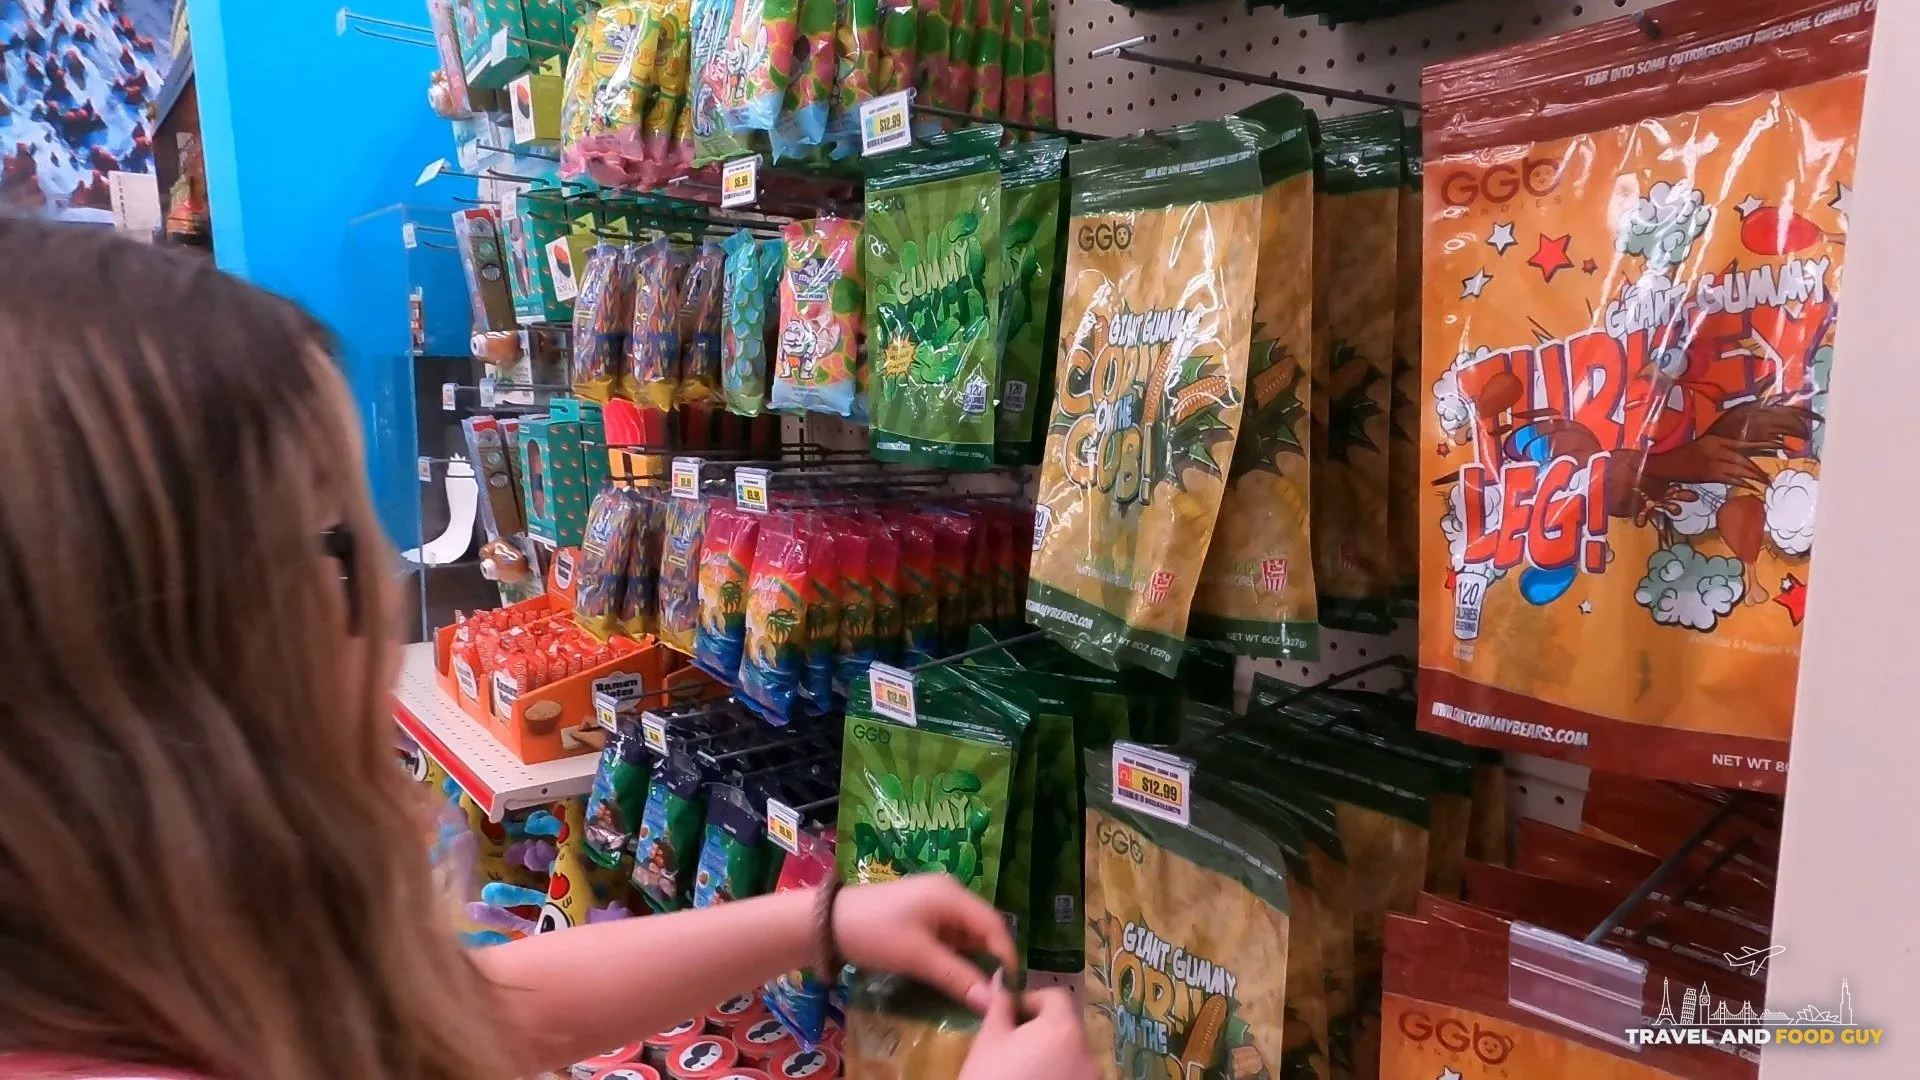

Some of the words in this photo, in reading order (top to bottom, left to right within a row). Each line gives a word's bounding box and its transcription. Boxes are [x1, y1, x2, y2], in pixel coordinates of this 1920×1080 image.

[1584, 67, 1610, 86] TEAR
[1609, 64, 1634, 82] INTO
[1636, 56, 1668, 77] SOME
[1668, 33, 1752, 66] OUTRAGEOUSLY
[1753, 17, 1812, 45] AWESOME
[896, 239, 969, 305] GUMMY
[1605, 282, 1688, 339] GIANT
[1696, 254, 1831, 315] GUMMY
[1109, 313, 1145, 346] GIANT
[1009, 382, 1024, 397] 120
[1063, 412, 1152, 506] COB!
[1459, 451, 1612, 574] LEG!
[1458, 581, 1480, 606] 120
[1244, 634, 1260, 643] WT
[1712, 753, 1744, 767] NET
[1746, 757, 1772, 772] WT
[1141, 776, 1178, 802] $12.99
[874, 794, 969, 832] GUMMY
[1123, 921, 1171, 973] GIANT
[1172, 947, 1238, 998] GUMMY
[1115, 1004, 1137, 1044] ON
[1139, 1016, 1169, 1055] THE
